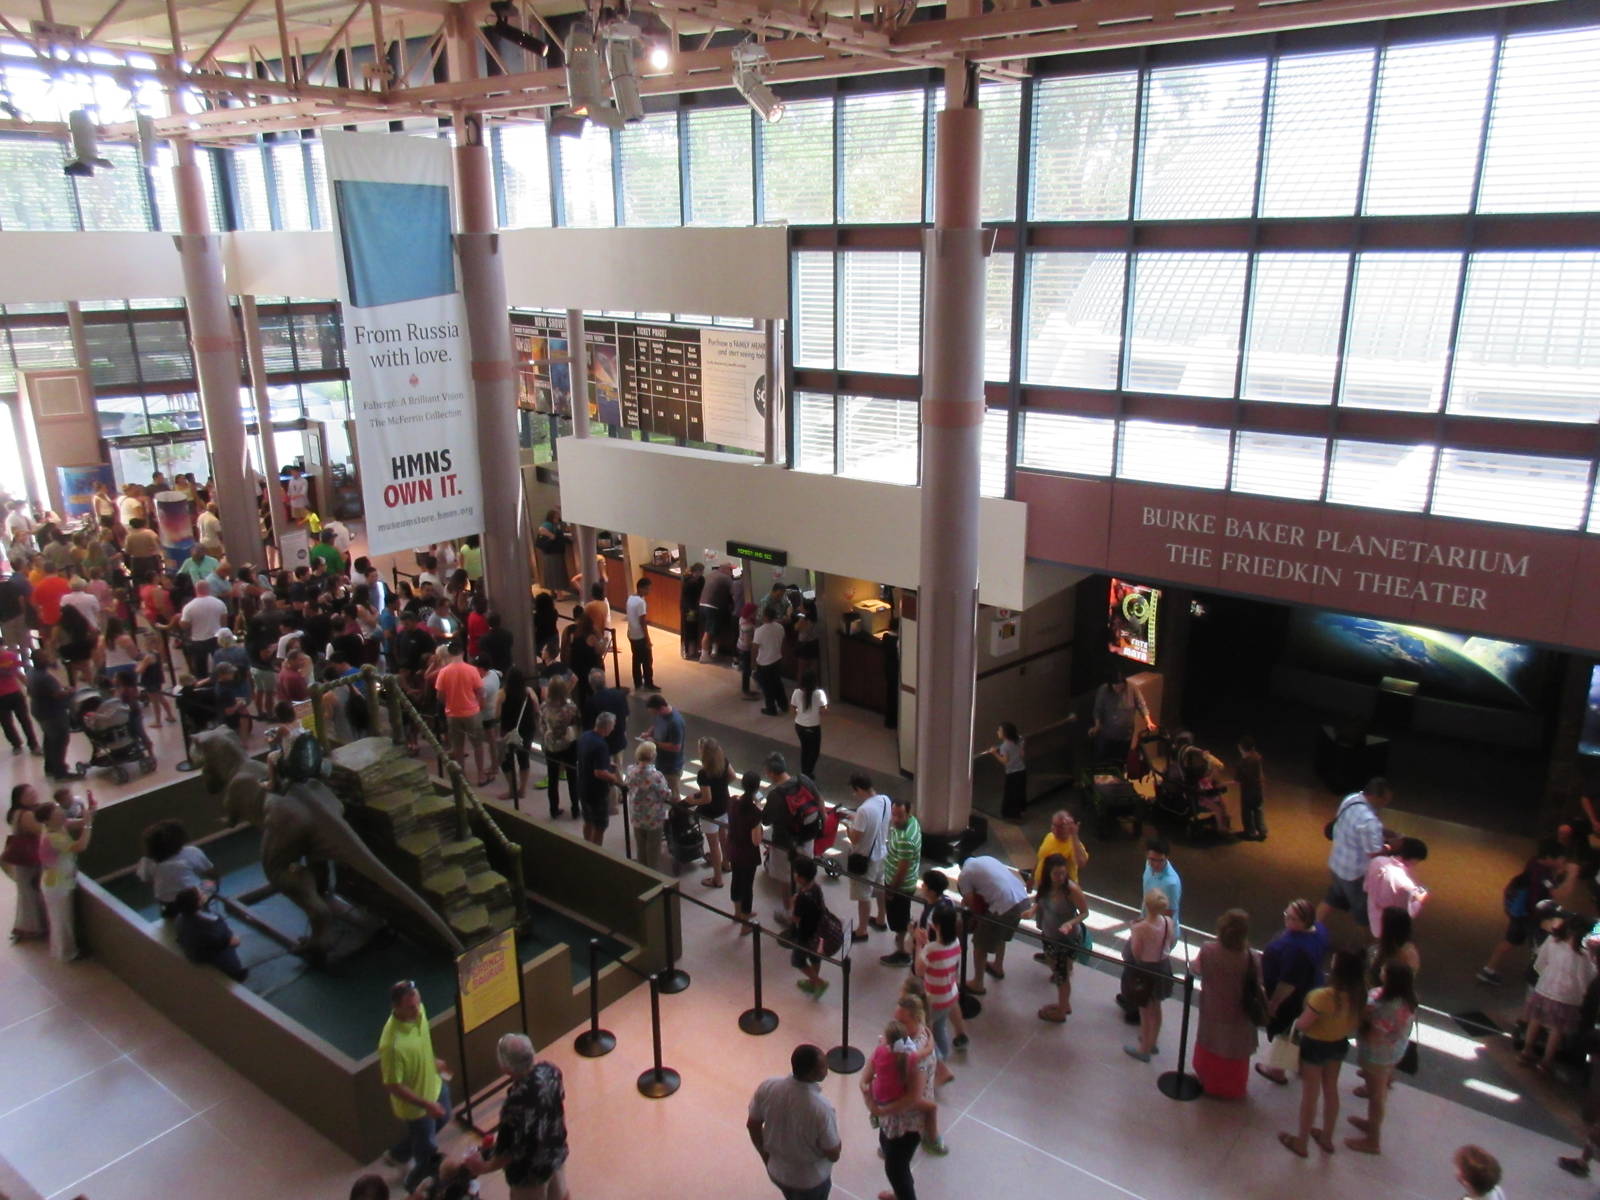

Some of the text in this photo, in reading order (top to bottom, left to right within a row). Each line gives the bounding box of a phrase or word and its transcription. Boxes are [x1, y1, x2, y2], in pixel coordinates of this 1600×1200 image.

[354, 321, 460, 344] From Russia
[370, 347, 452, 368] with love.
[399, 398, 407, 406] A
[409, 394, 440, 405] Brilliant
[441, 391, 464, 401] Vision
[369, 408, 462, 428] The McFerrin Collection
[392, 449, 452, 480] HMNS
[384, 474, 462, 508] OWN IT.
[1142, 506, 1531, 577] BURKE BAKER PLANETARIUM
[1166, 543, 1489, 610] THE FRIEDKIN THEATER
